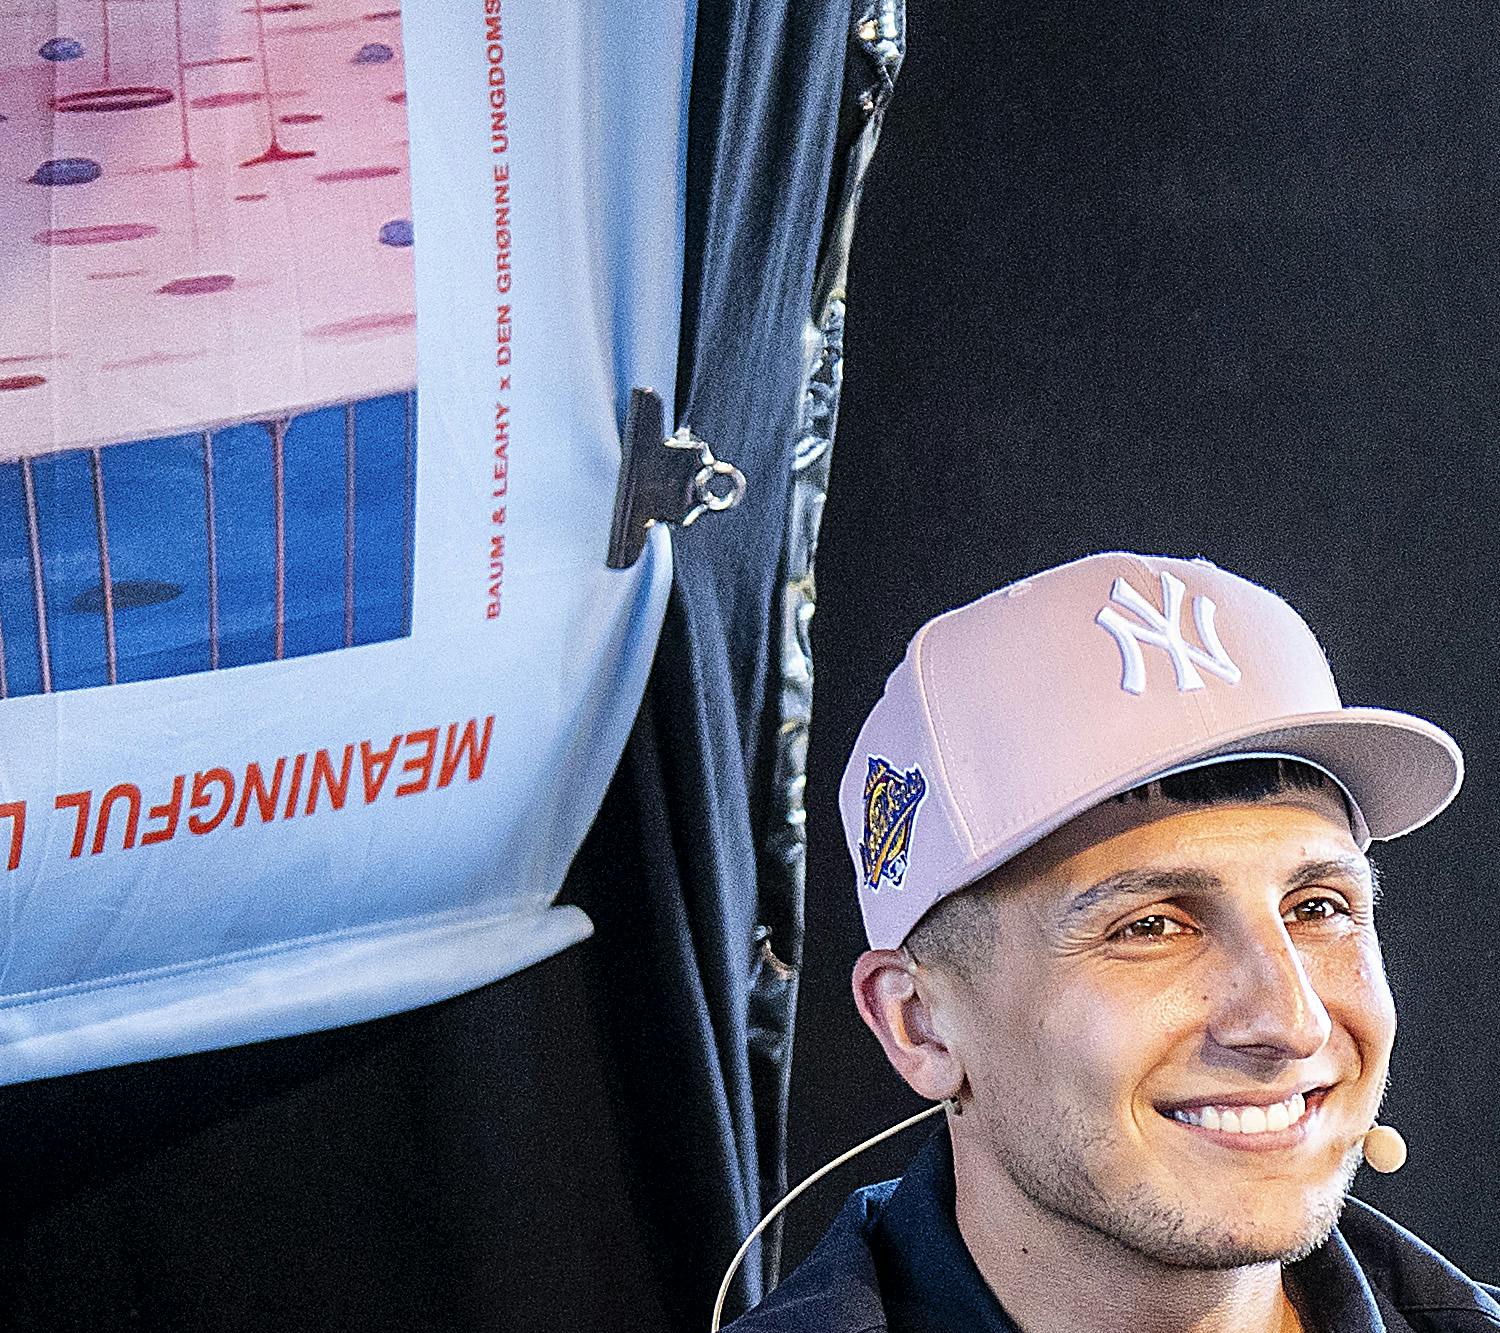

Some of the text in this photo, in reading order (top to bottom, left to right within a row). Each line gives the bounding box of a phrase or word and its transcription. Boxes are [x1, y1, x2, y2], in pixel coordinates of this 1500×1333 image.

[494, 164, 512, 294] GRØNNE
[496, 304, 512, 366] DEN
[493, 402, 511, 497] LEAHY
[491, 506, 507, 525] &
[486, 533, 505, 620] BAUM
[1094, 570, 1242, 695] NY
[54, 715, 495, 859] MEANINGFUL
